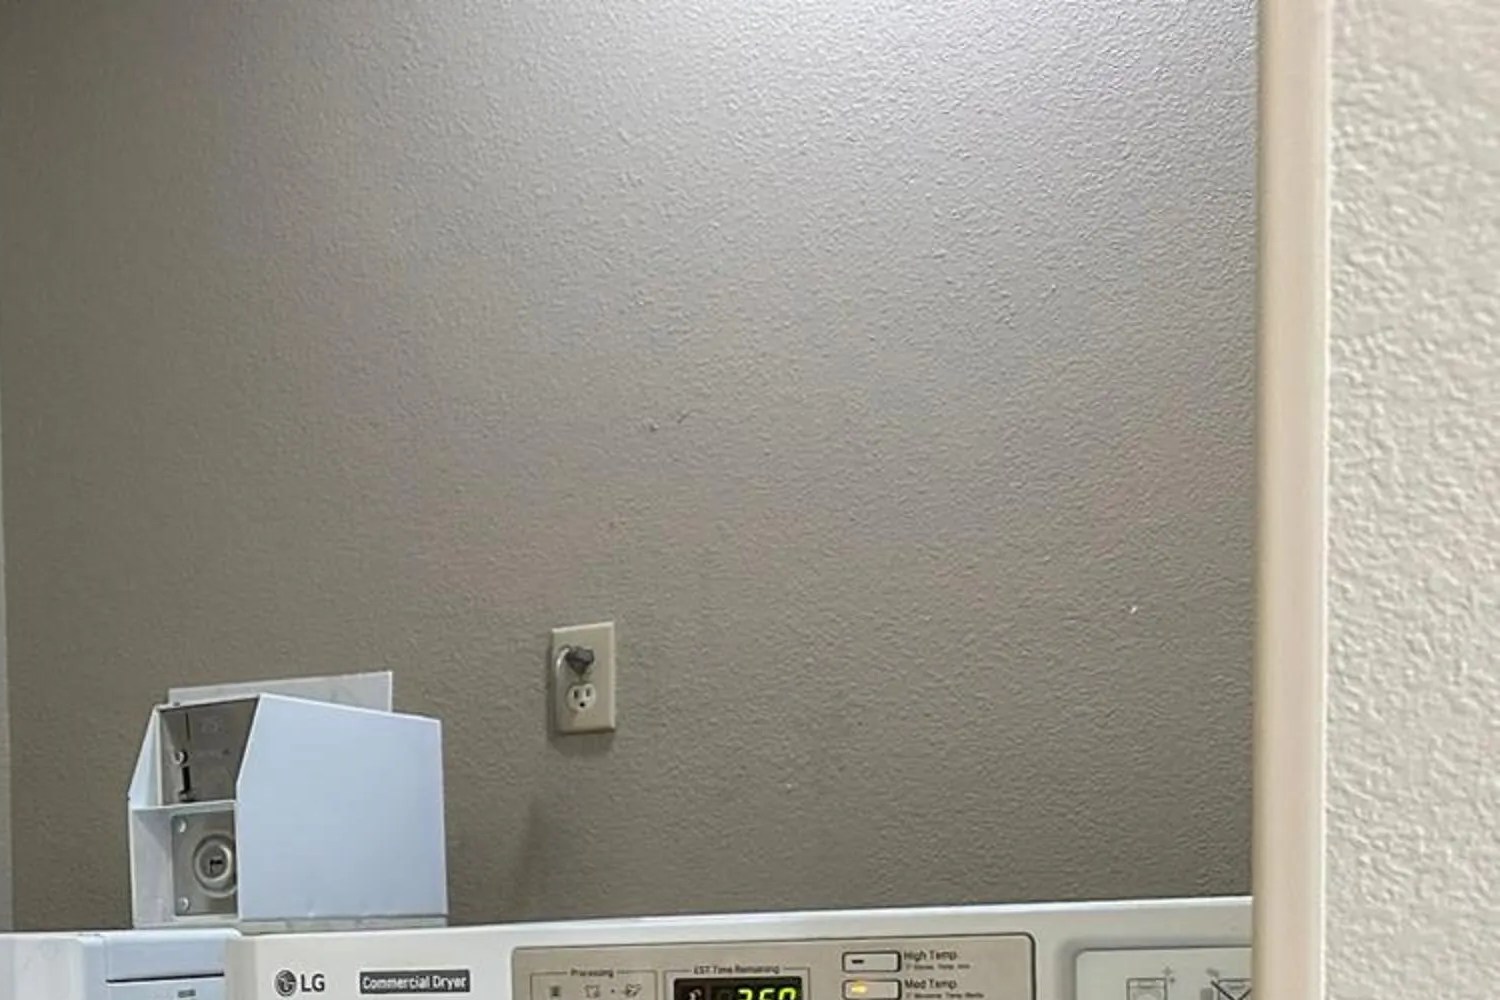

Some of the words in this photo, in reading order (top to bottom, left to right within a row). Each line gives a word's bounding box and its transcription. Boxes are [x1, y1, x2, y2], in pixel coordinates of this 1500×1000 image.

[904, 951, 927, 962] High
[570, 967, 614, 979] Processing
[693, 965, 712, 975] EST
[713, 966, 733, 974] Time
[735, 964, 780, 975] Remaining
[300, 973, 326, 993] LG
[363, 976, 430, 990] Commercial
[432, 974, 467, 990] Dryer
[904, 978, 927, 989] Med
